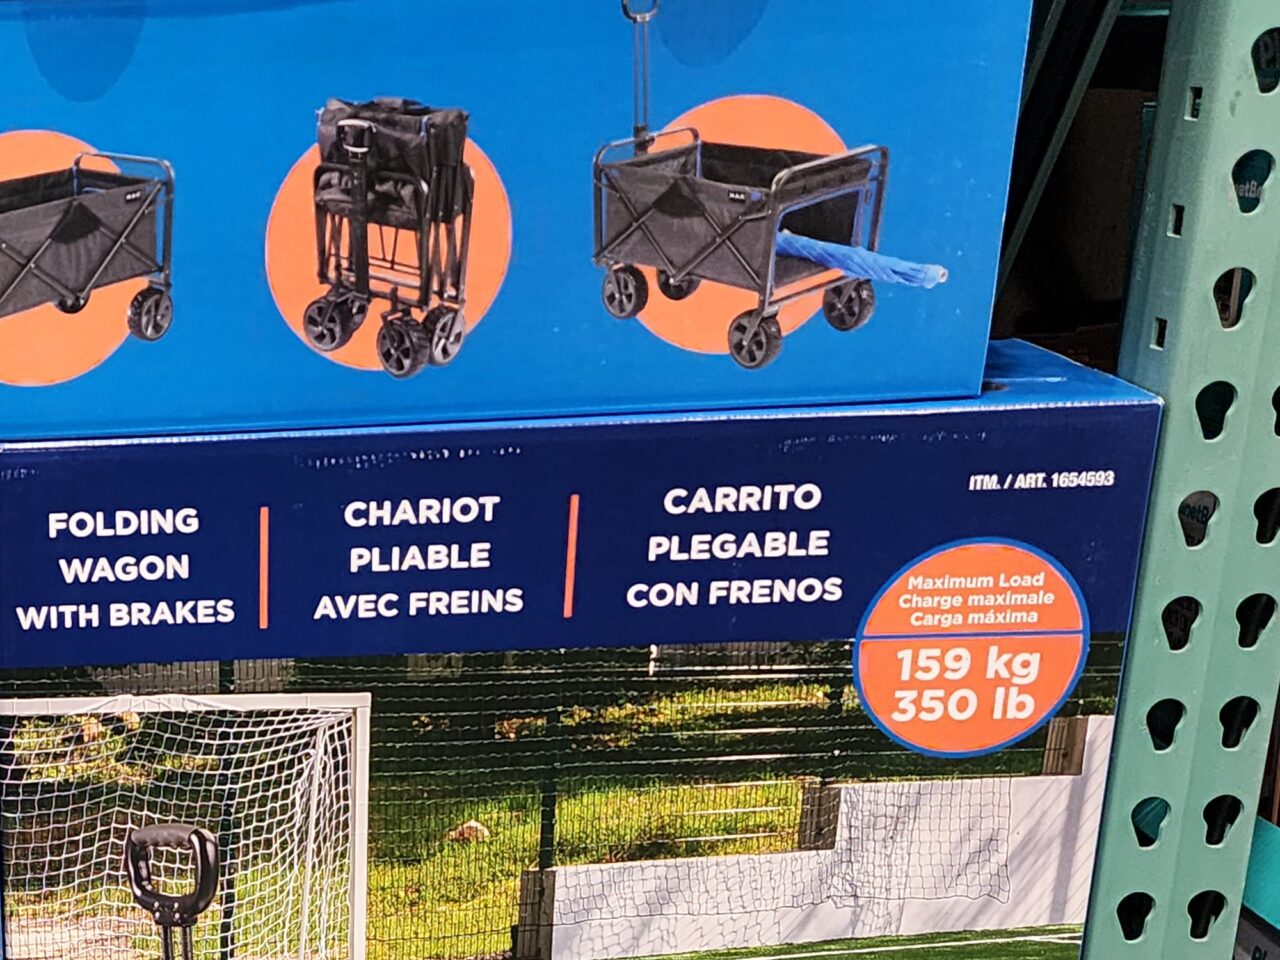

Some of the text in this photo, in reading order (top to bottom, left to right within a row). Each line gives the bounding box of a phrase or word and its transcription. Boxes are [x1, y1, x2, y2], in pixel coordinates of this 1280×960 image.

[969, 475, 1001, 491] ITM.
[1015, 473, 1047, 489] ART.
[1051, 471, 1115, 488] 1654593
[344, 496, 500, 528] CHARIOT
[664, 484, 822, 515] CARRITO
[48, 508, 199, 538] FOLDING
[350, 543, 491, 573] PLIABLE
[648, 531, 830, 562] PLEGABLE
[58, 555, 190, 584] WAGON
[908, 572, 1045, 590] Maximum Load
[313, 588, 524, 620] AVEC FREINS
[626, 577, 843, 608] CON FRENOS
[898, 589, 1055, 611] Charge maximale
[16, 599, 235, 630] WITH BRAKES
[910, 607, 1039, 628] Carga máxima
[895, 646, 1041, 687] 159 kg
[891, 686, 1036, 722] 350 lb
